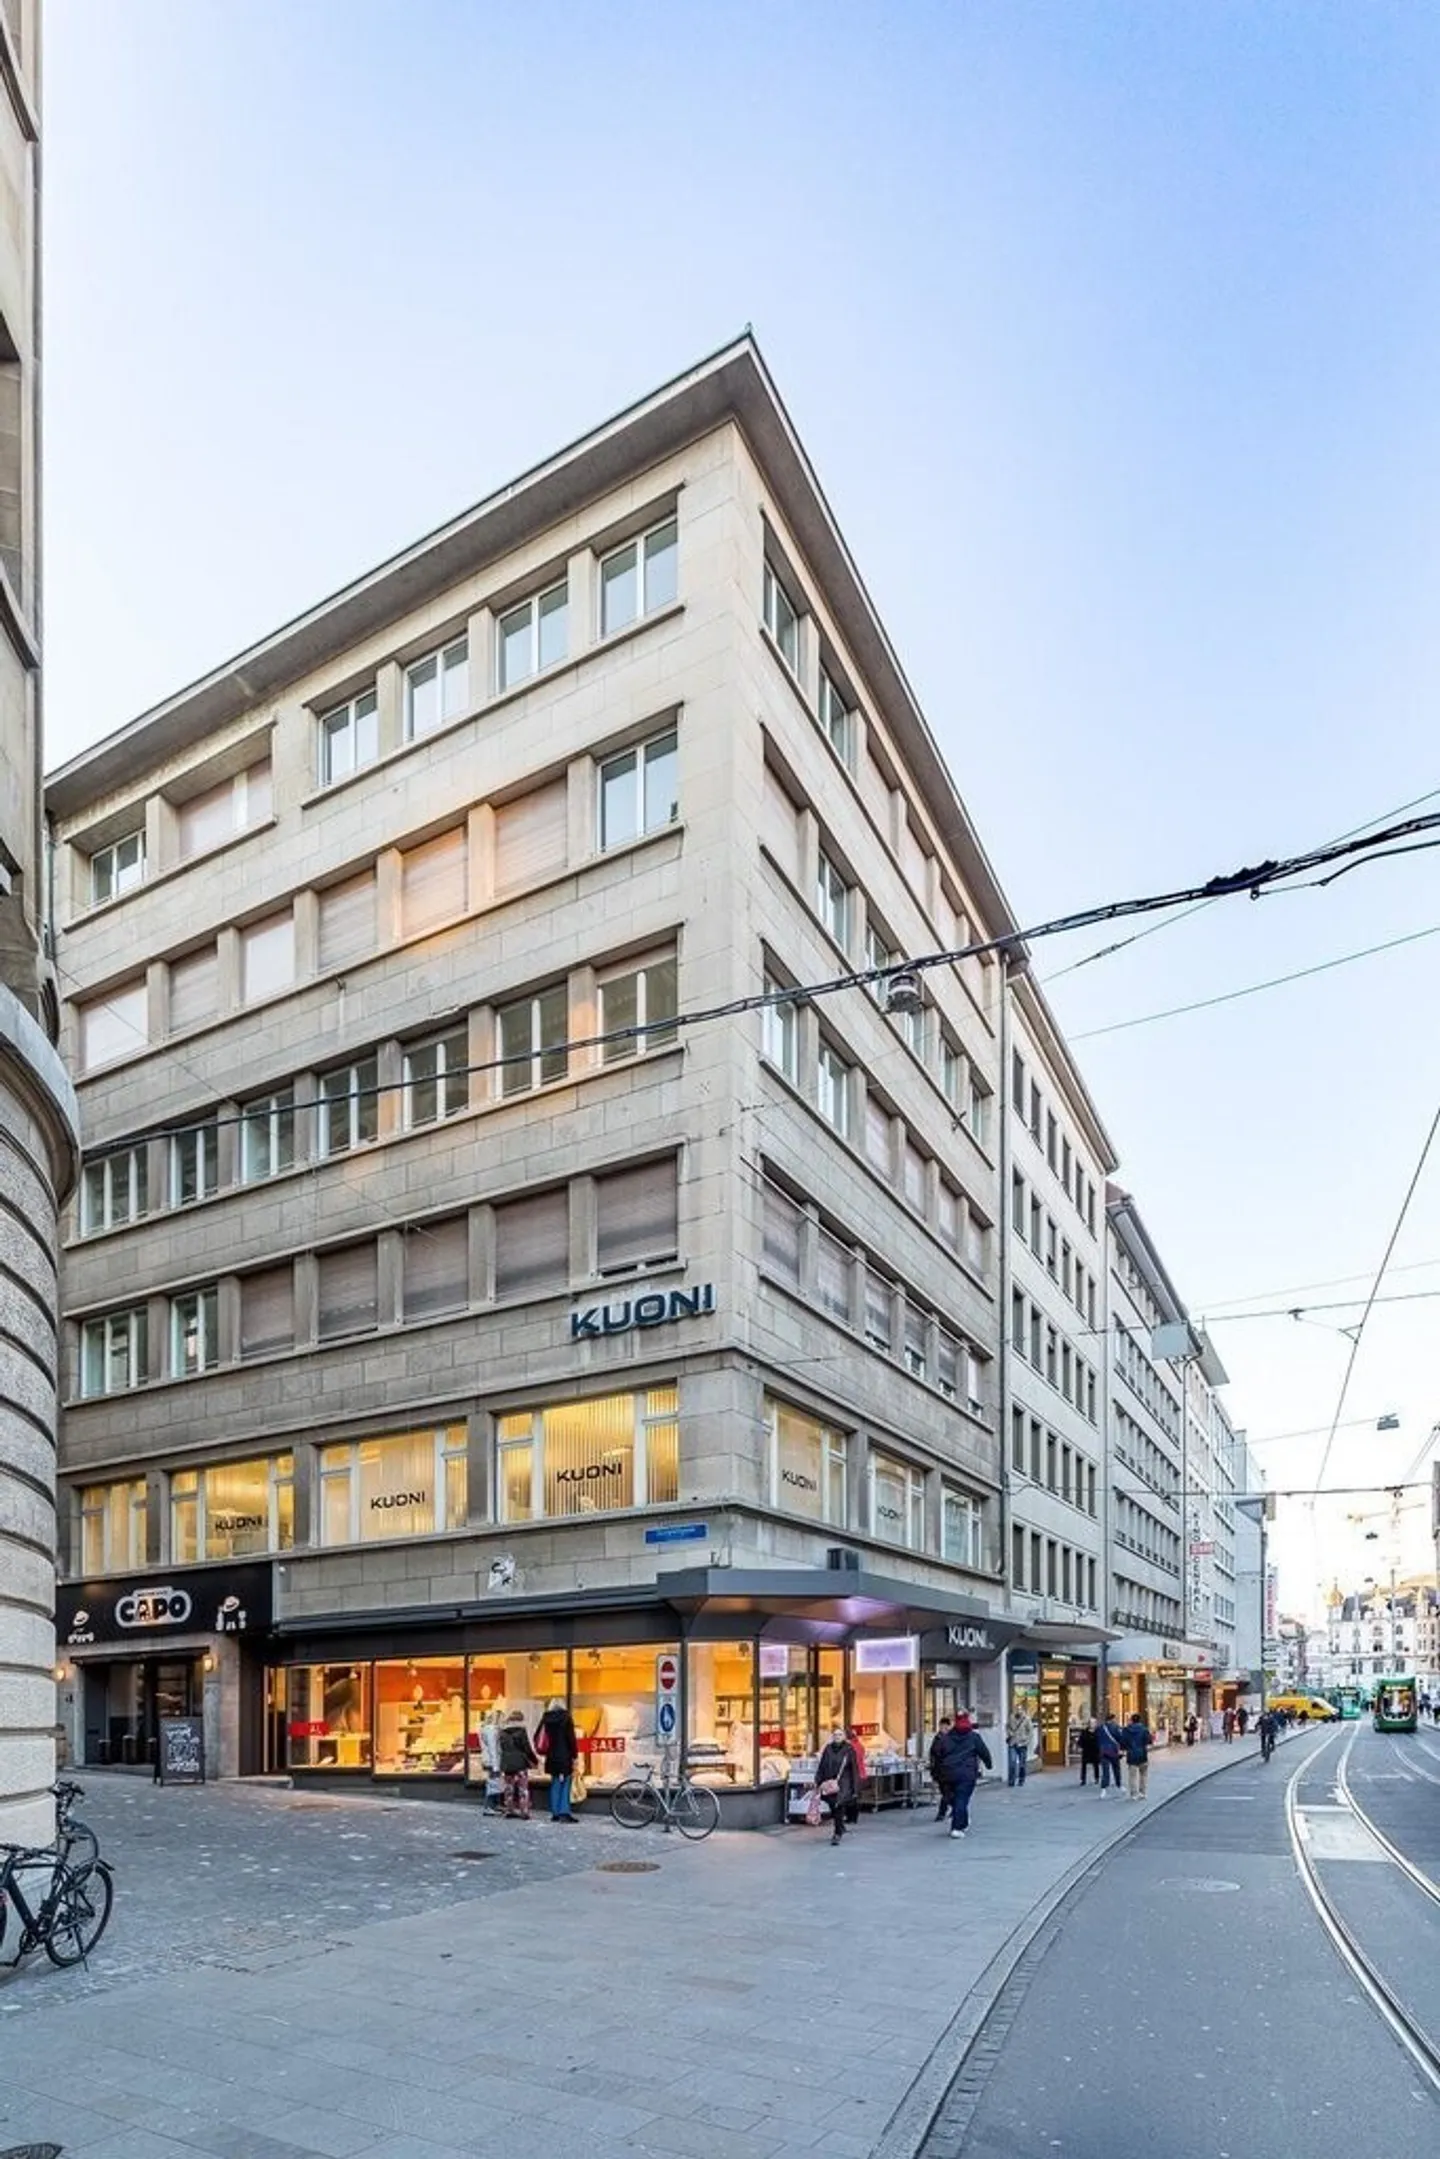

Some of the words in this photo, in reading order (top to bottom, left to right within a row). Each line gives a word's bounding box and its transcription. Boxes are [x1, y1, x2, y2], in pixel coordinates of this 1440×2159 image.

[571, 1283, 714, 1337] KUONI
[556, 1463, 622, 1483] KUONI
[781, 1468, 817, 1492] KUONI
[371, 1490, 425, 1510] KUONI
[215, 1515, 262, 1532] KUONI
[119, 1595, 187, 1624] CAPO
[590, 1738, 625, 1752] SALE
